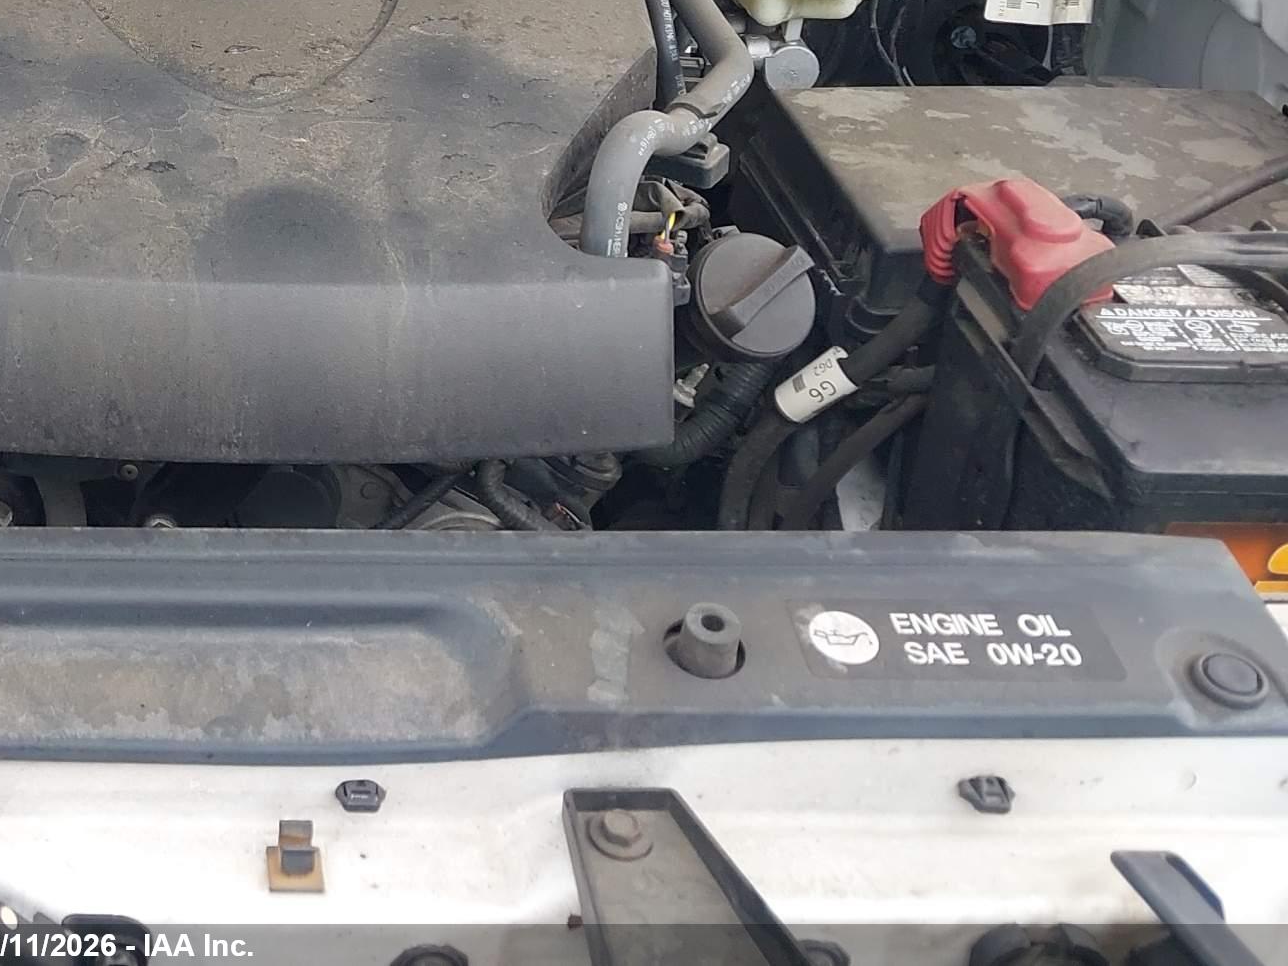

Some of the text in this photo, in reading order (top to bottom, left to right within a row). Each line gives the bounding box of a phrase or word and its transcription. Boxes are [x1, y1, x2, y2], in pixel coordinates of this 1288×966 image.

[1113, 308, 1182, 318] DANGER
[1195, 309, 1257, 318] POISON
[809, 380, 837, 403] G6
[889, 613, 1072, 637] ENGINE OIL
[904, 642, 1082, 667] SAE 0W-20
